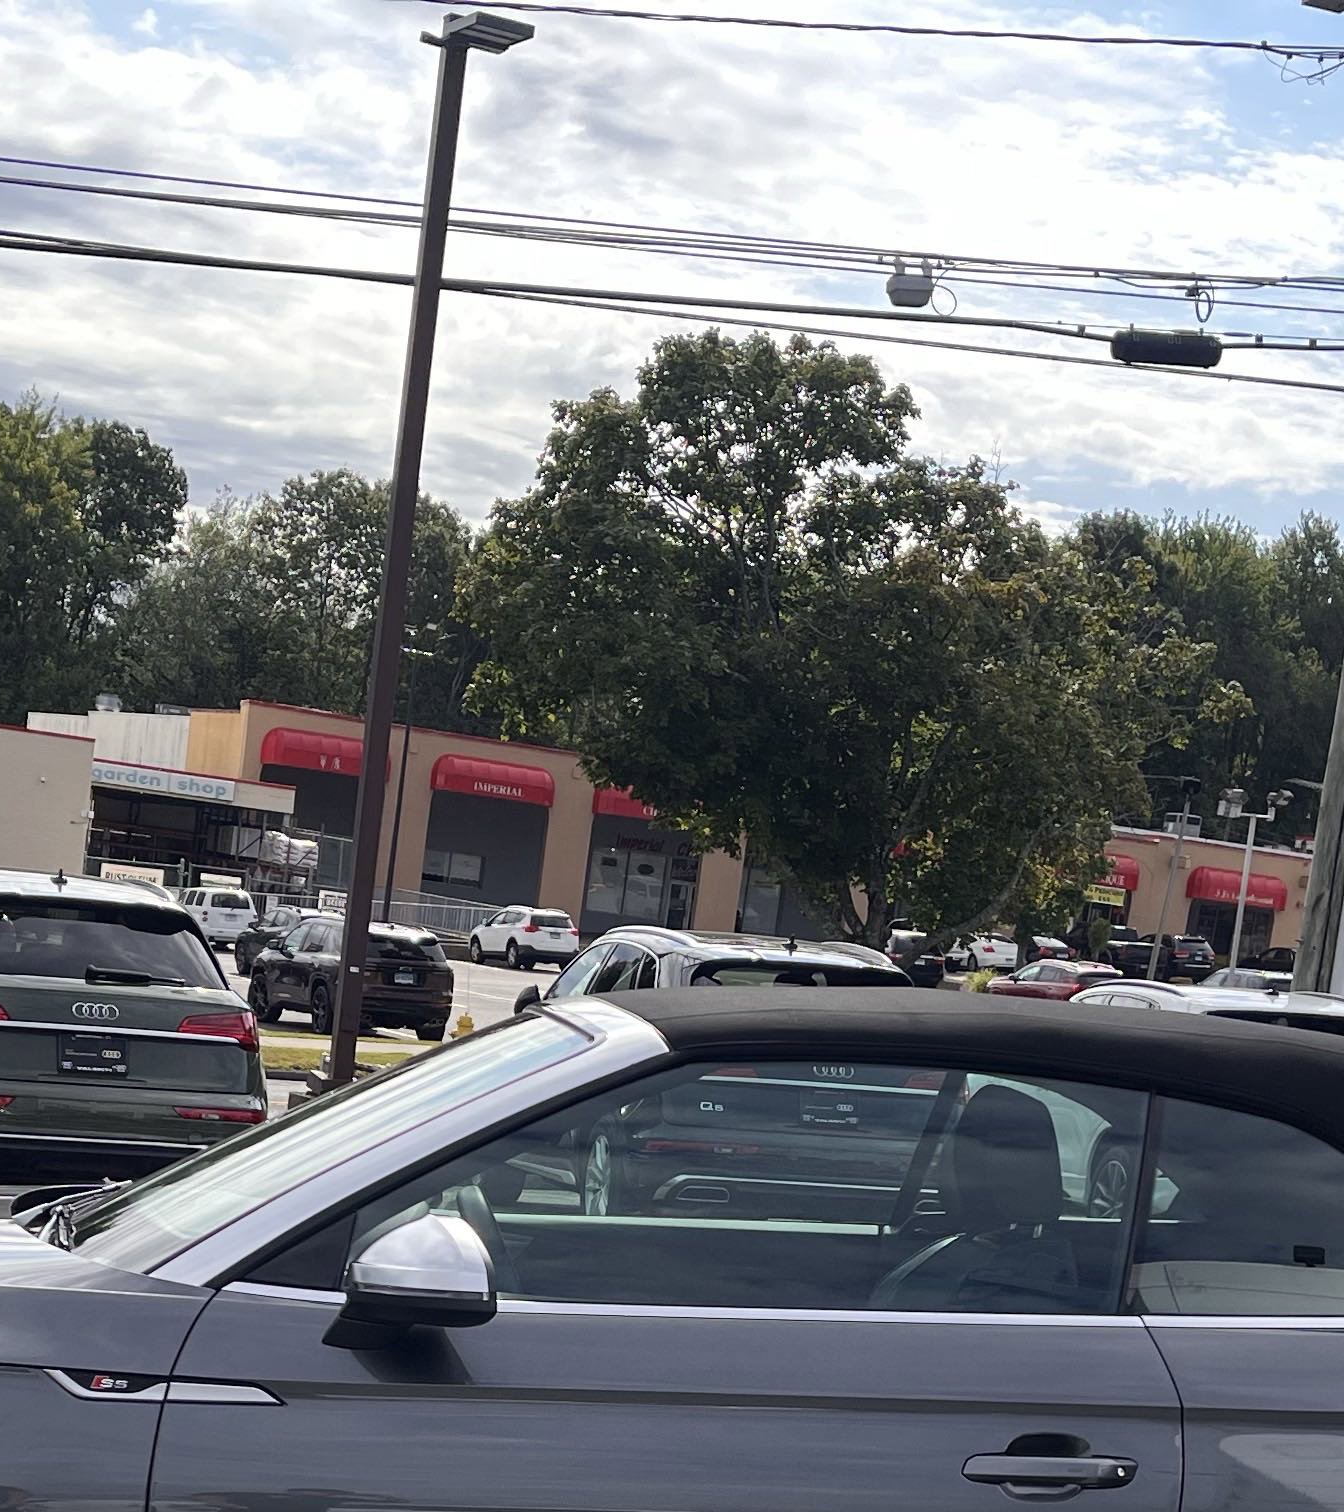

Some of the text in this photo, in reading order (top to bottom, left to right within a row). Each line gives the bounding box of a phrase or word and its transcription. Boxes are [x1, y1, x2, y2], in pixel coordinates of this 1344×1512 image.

[92, 767, 227, 799] garden shop
[473, 781, 525, 799] IMPERIAL
